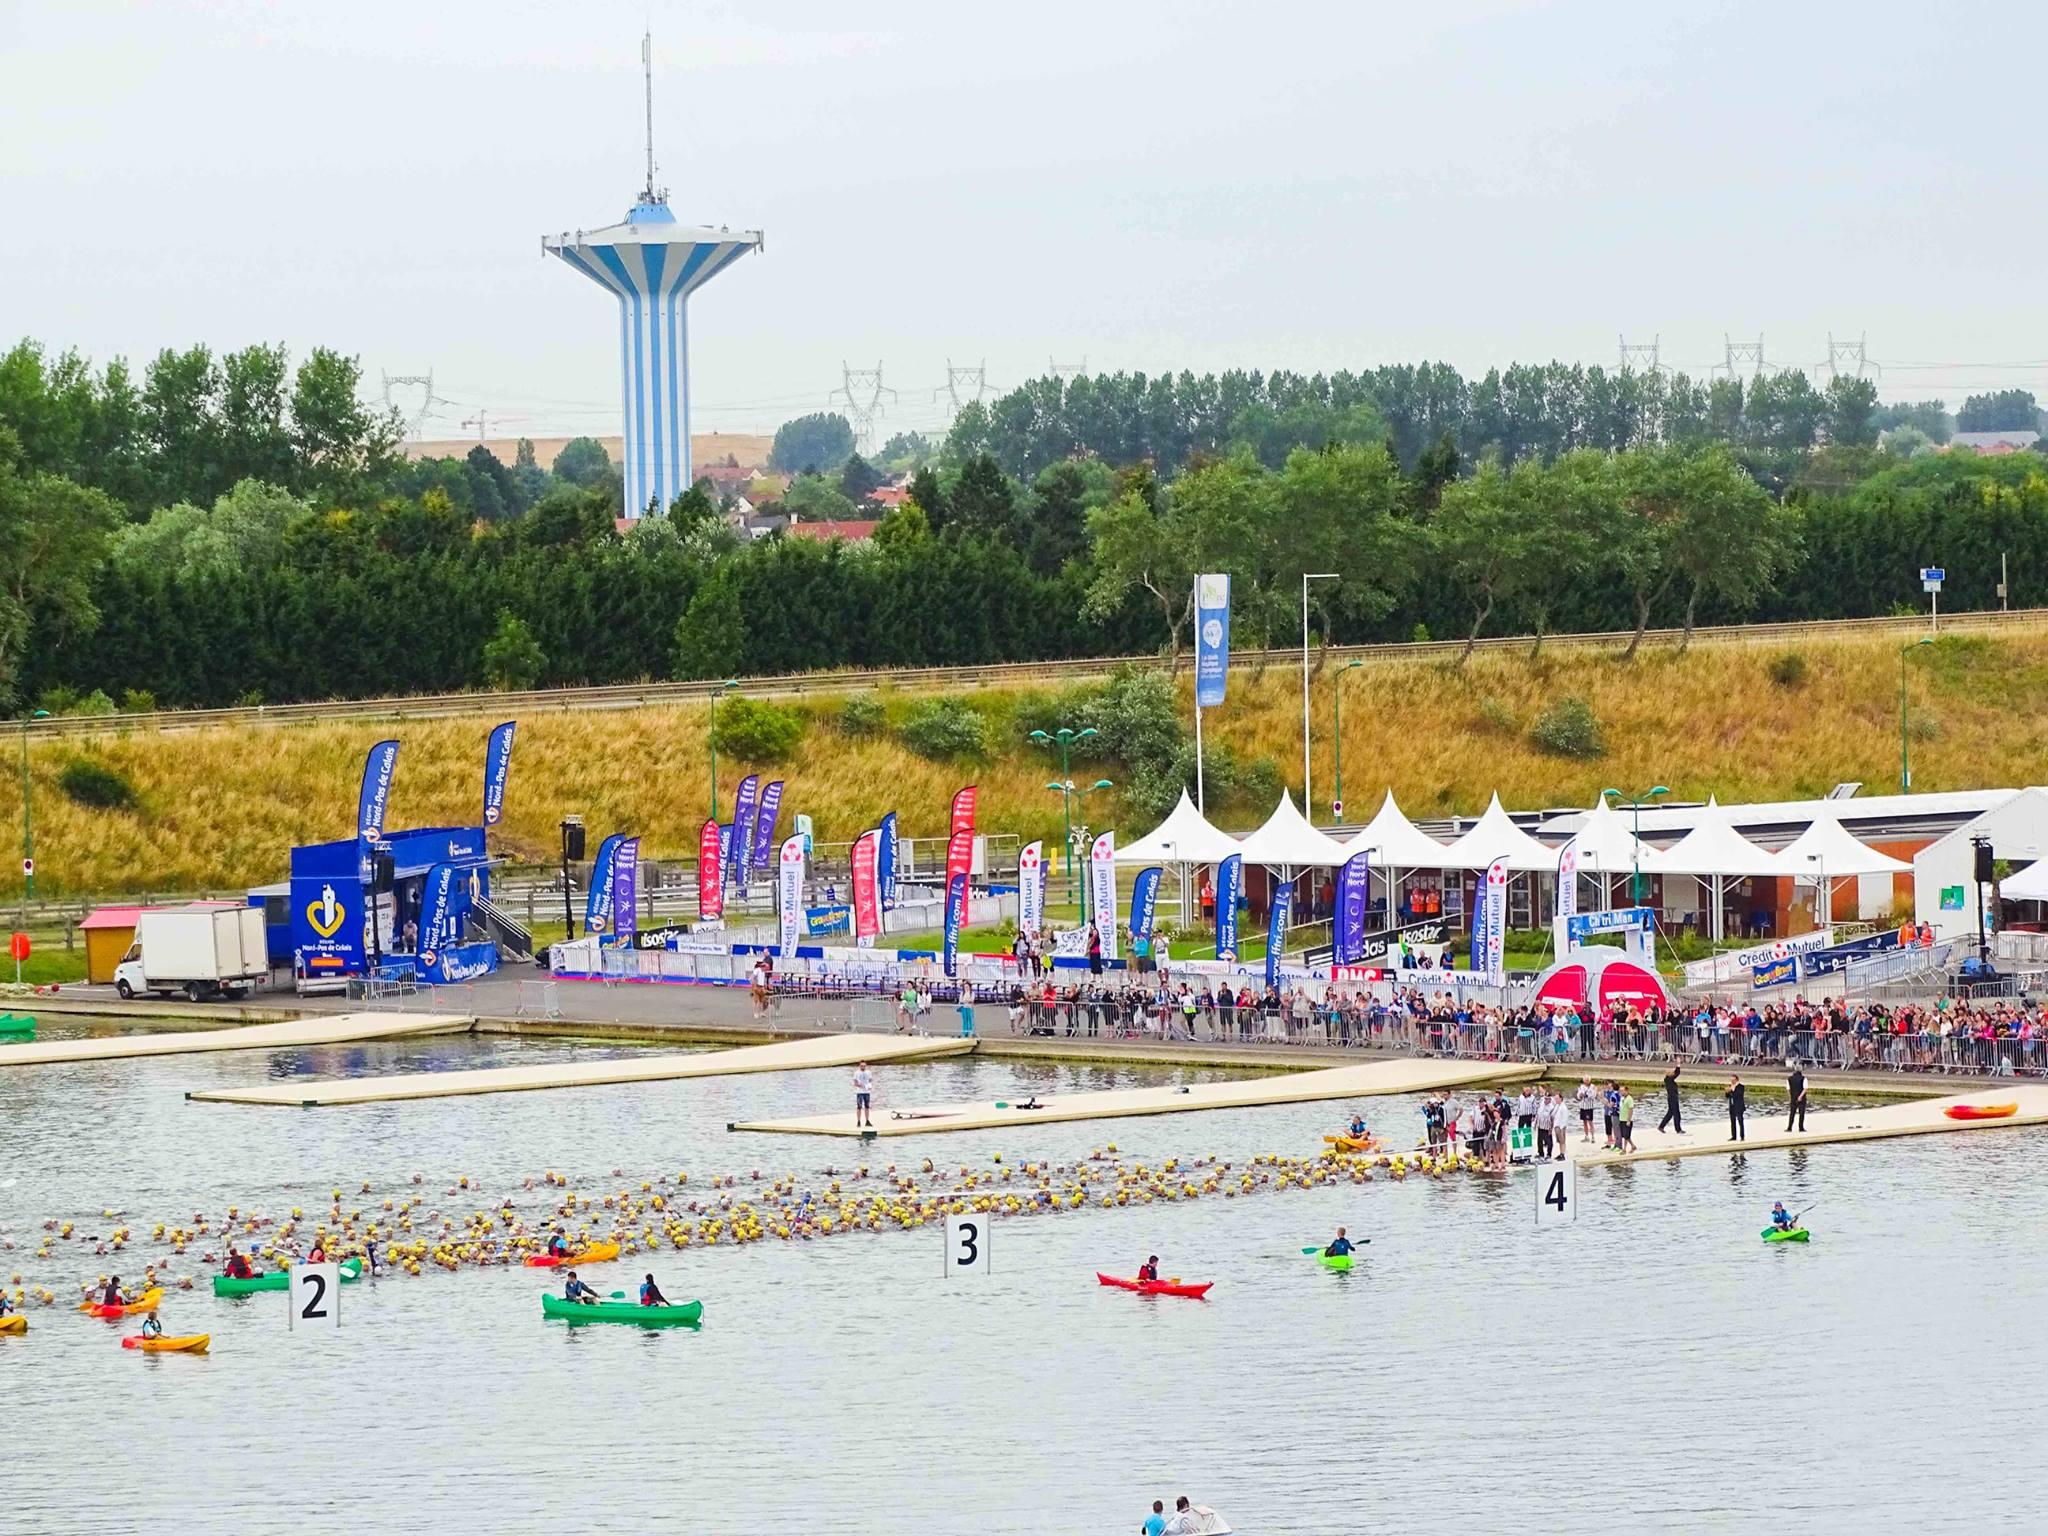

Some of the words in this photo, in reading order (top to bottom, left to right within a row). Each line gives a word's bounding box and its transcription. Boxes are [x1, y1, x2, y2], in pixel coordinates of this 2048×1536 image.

[502, 728, 512, 755] Calais
[380, 747, 395, 774] Calais
[720, 831, 730, 857] Calais
[439, 868, 451, 895] Calais
[1098, 869, 1107, 910] Mutuel
[1146, 874, 1158, 902] Calais
[1230, 861, 1239, 890] Calais
[786, 870, 794, 911] Mutuel
[1024, 878, 1032, 919] Mutuel
[1144, 904, 1153, 915] de
[1491, 894, 1500, 936] Mutuel
[1614, 913, 1633, 924] Man
[948, 899, 962, 974] www.fftri.com
[1140, 916, 1150, 933] Pas
[1402, 924, 1443, 944] isostar
[1271, 909, 1286, 986] www.fftri.com
[1738, 950, 1774, 966] Crédit
[1786, 936, 1825, 956] Mutuel
[1545, 1171, 1567, 1212] 4
[958, 1223, 978, 1265] 3
[302, 1274, 327, 1319] 2
